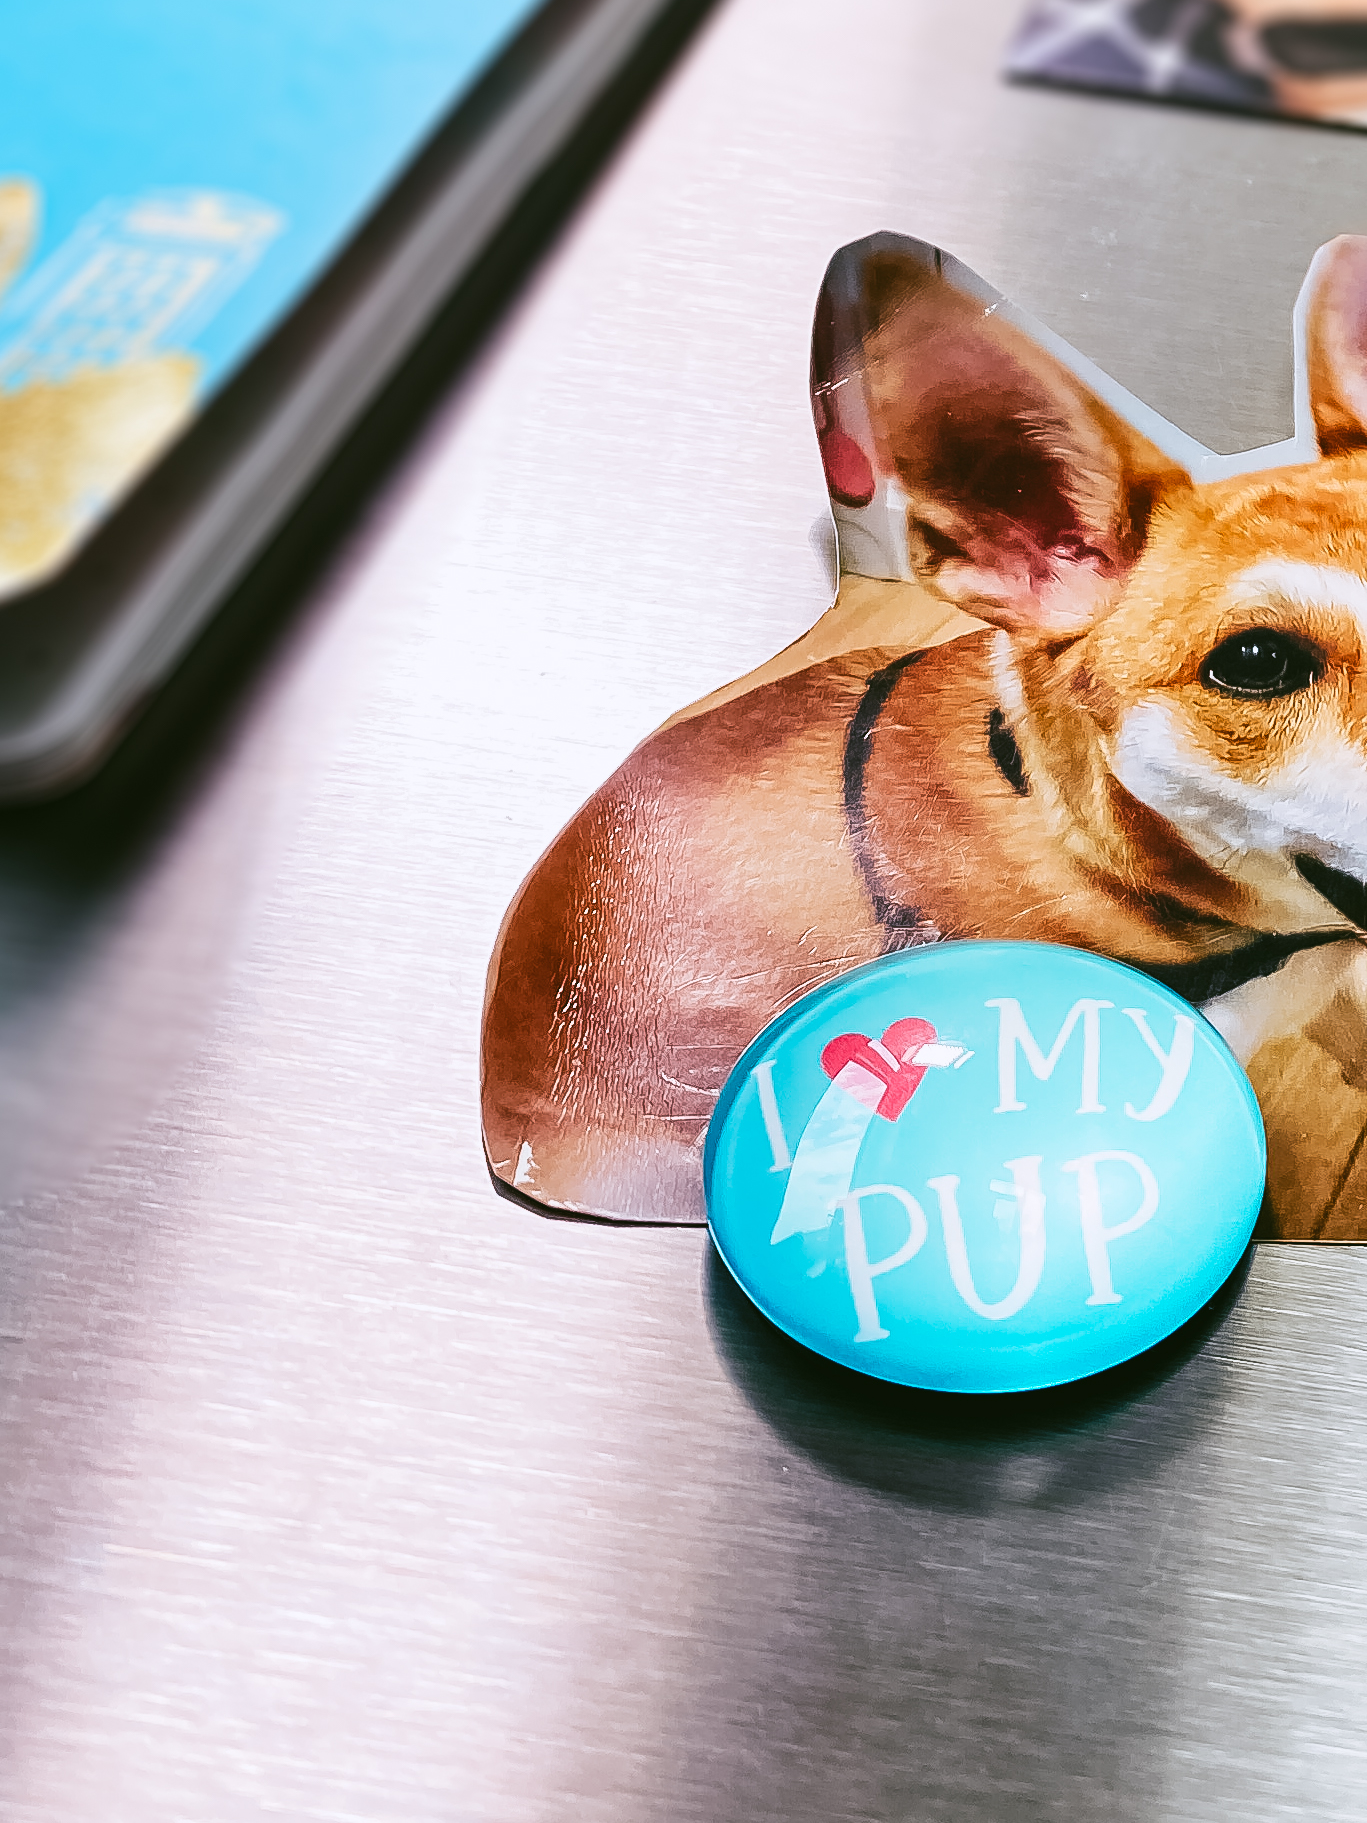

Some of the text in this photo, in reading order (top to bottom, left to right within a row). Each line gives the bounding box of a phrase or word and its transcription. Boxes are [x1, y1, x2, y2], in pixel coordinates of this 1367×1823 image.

[749, 996, 1199, 1173] I MY
[834, 1148, 1161, 1343] PUP
